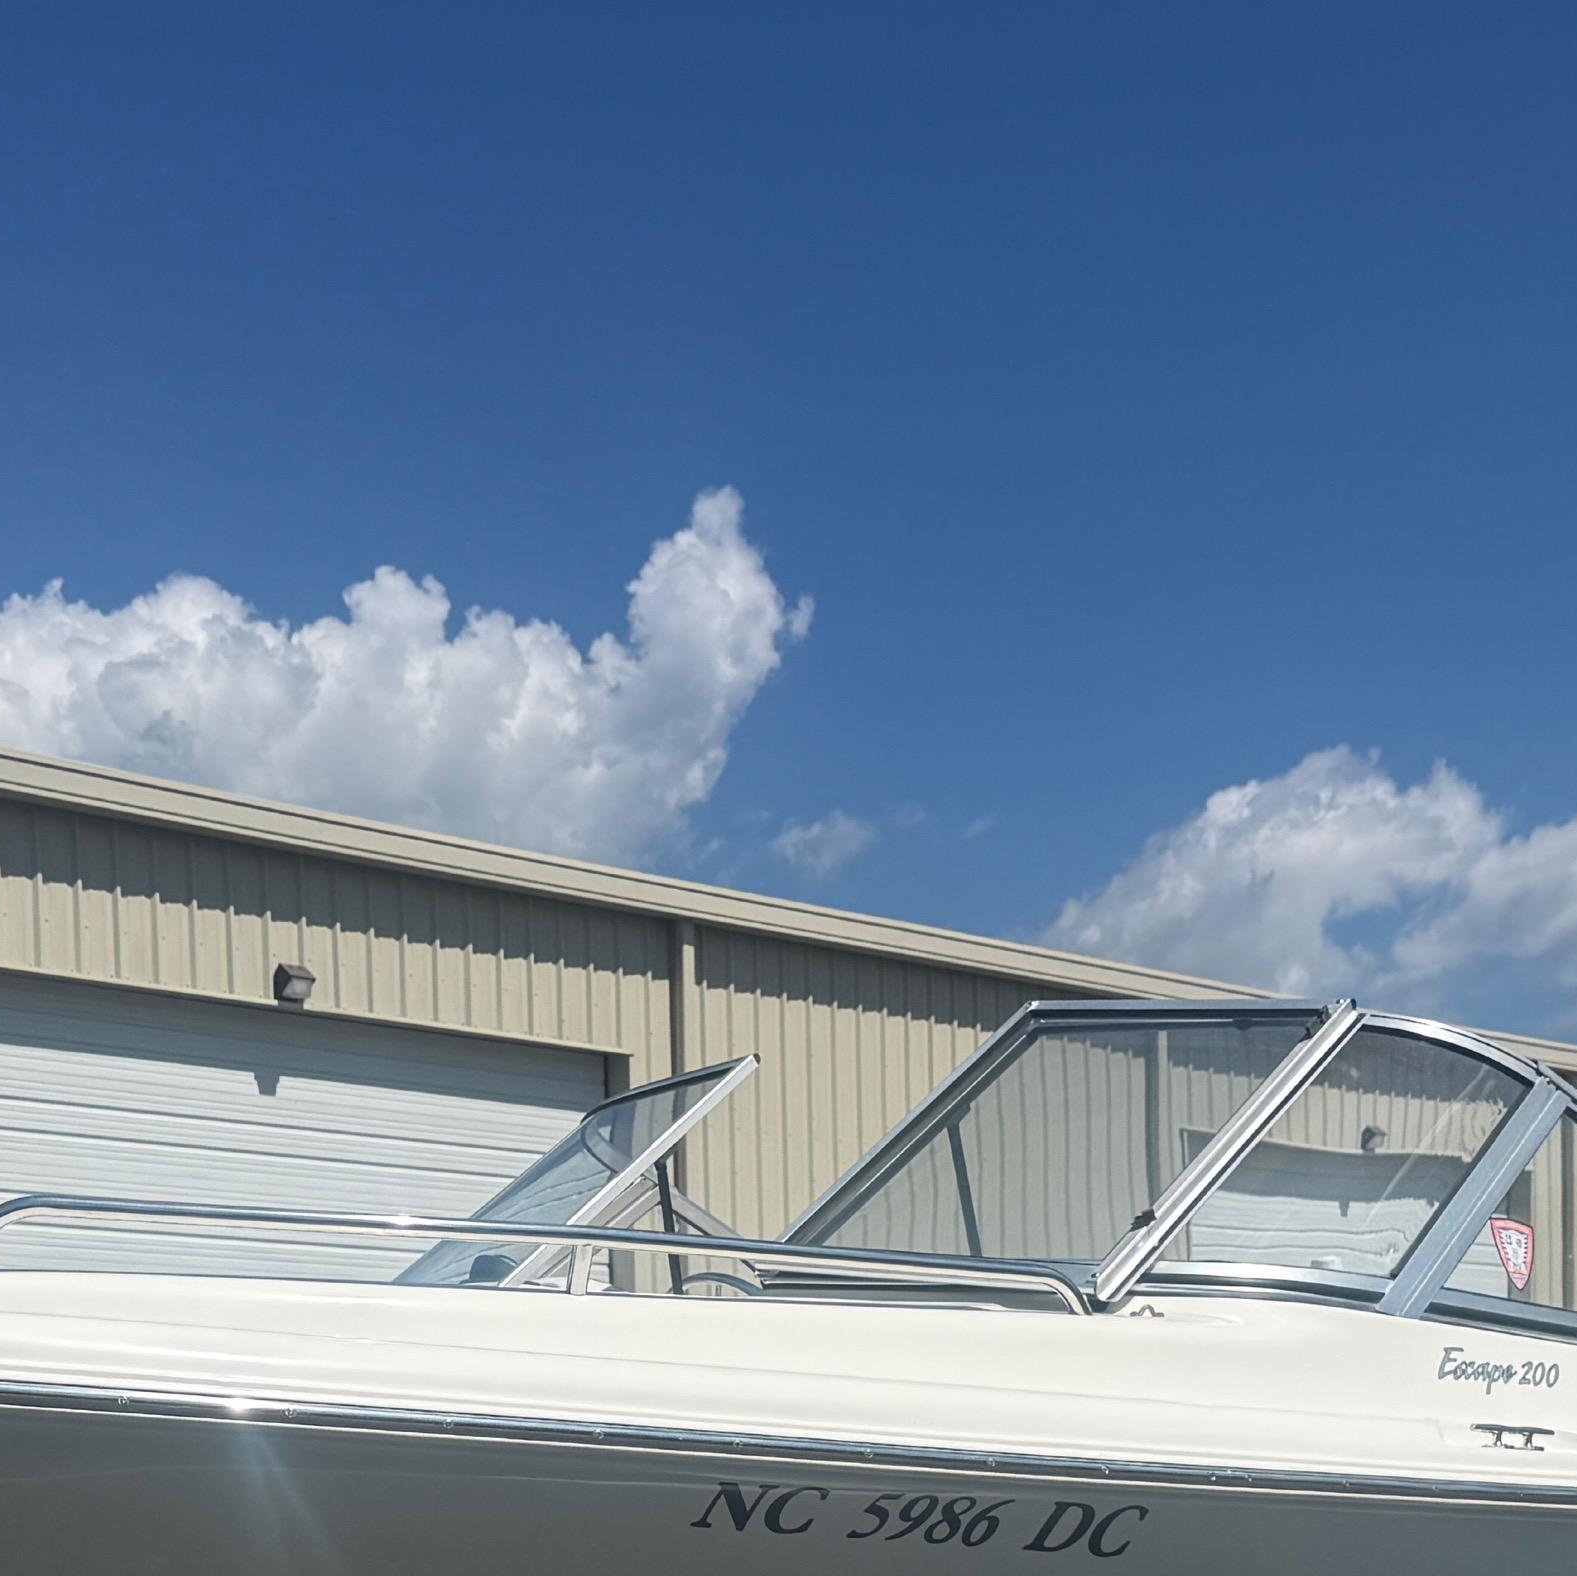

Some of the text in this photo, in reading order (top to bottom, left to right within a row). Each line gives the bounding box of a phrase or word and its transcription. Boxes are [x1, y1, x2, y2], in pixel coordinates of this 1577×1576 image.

[1519, 1361, 1559, 1387] 200
[691, 1482, 1149, 1557] NC 5986 DC
